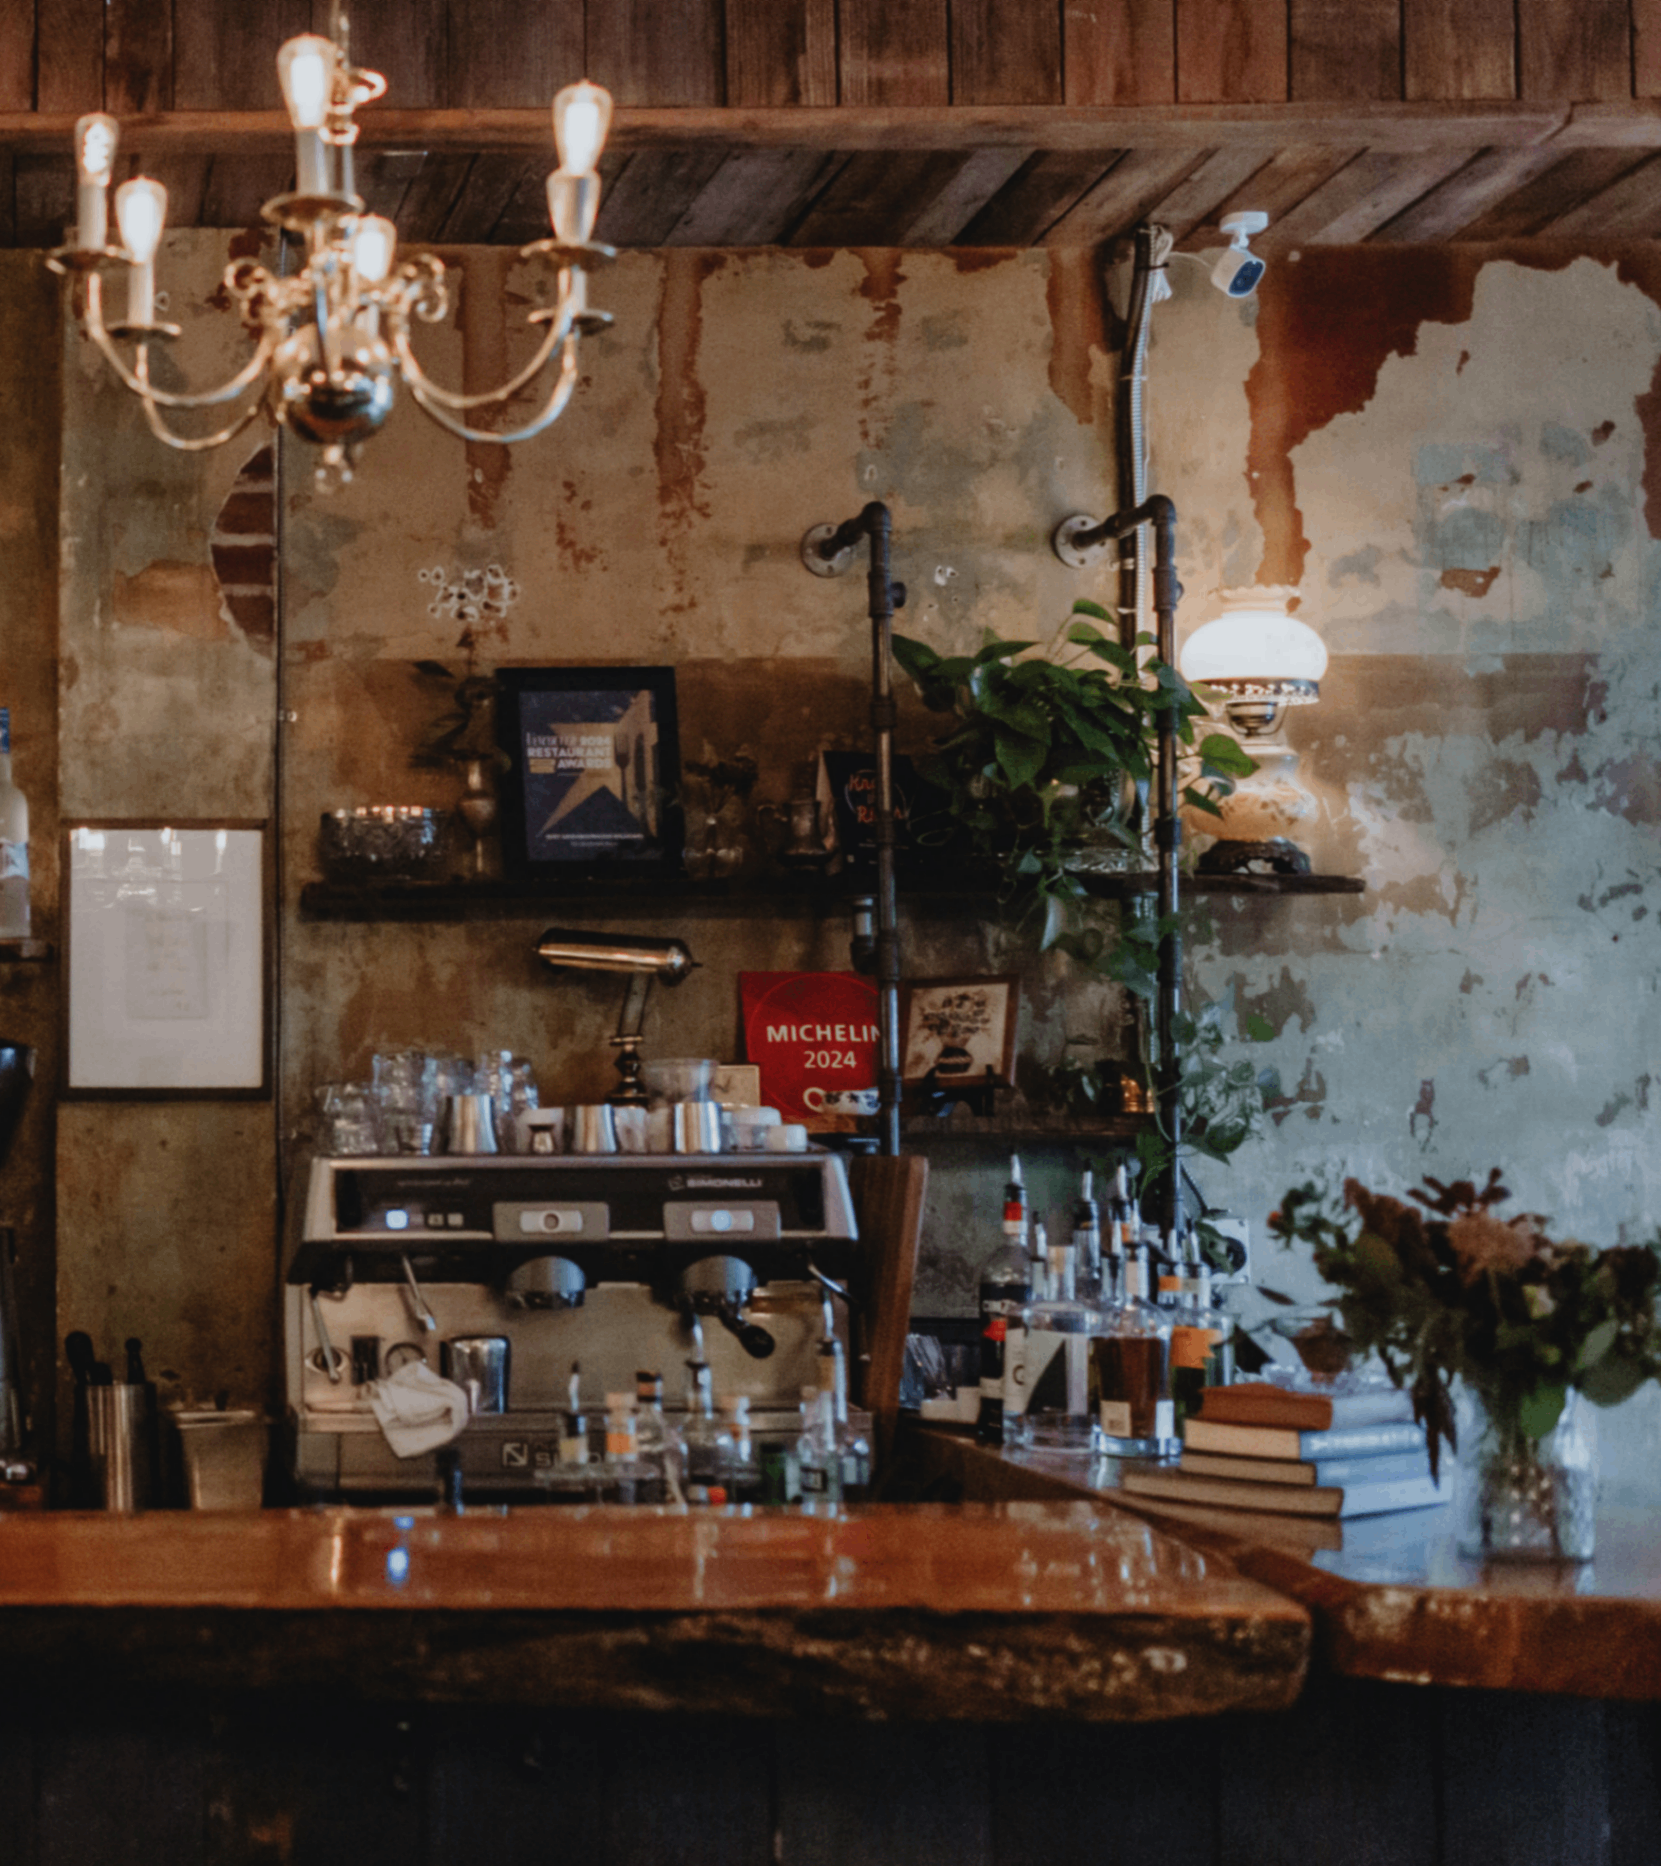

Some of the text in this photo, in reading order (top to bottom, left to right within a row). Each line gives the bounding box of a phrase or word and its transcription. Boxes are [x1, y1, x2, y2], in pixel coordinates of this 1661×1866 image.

[526, 746, 612, 758] RESTAURANT
[557, 758, 612, 769] AWARDS
[766, 1023, 881, 1043] MICHELIN
[803, 1050, 857, 1069] 2024
[686, 1177, 764, 1189] SIMONELLI
